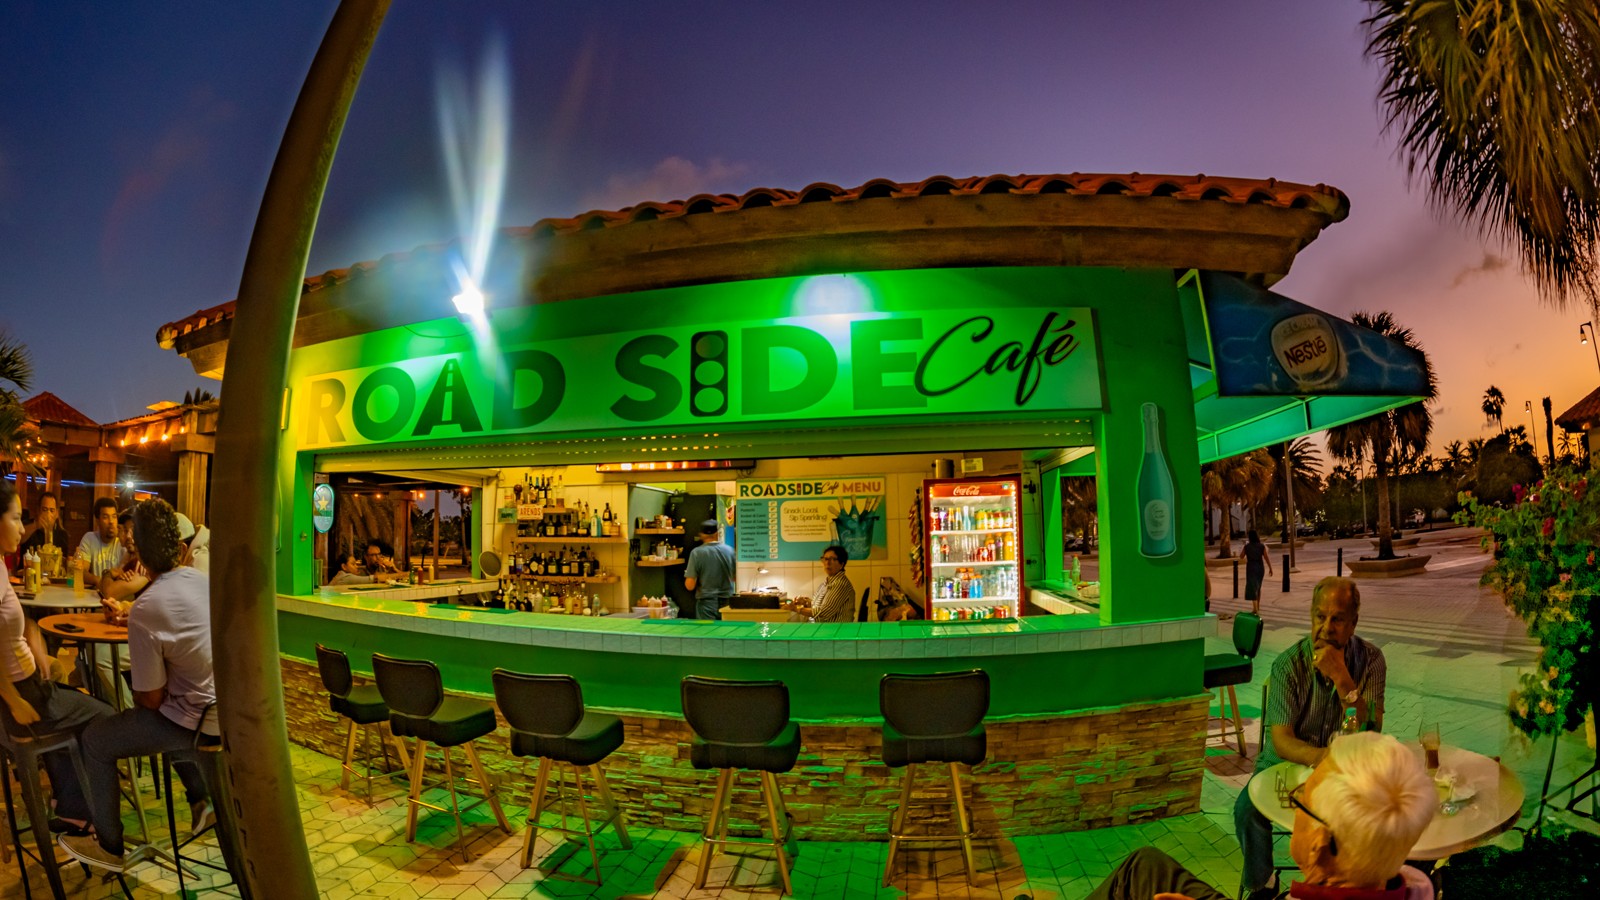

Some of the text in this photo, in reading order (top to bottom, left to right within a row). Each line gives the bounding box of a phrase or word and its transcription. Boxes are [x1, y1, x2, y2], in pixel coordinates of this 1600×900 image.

[1283, 335, 1327, 368] Nestlé
[306, 311, 1081, 445] ROAD SIDE Café
[740, 482, 823, 497] ROADSIDE
[842, 481, 881, 493] MENU
[784, 506, 818, 514] Snack Local
